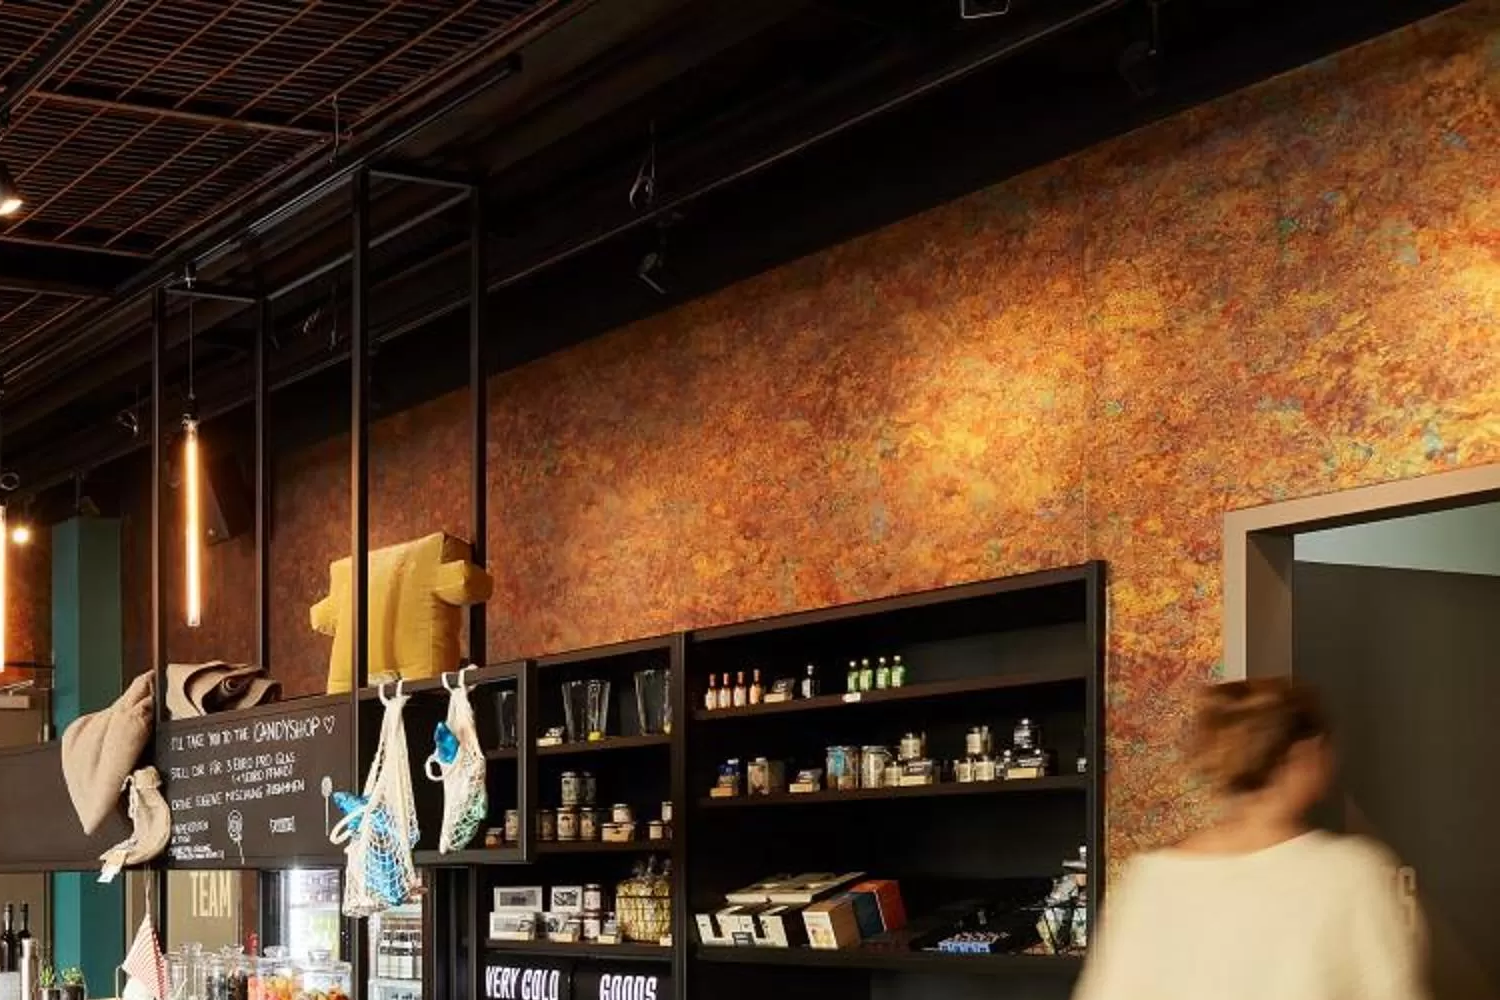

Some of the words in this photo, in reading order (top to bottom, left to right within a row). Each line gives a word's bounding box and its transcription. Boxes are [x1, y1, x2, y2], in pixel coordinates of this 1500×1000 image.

[233, 727, 250, 741] THE
[254, 716, 320, 742] CANDYSHOP
[189, 870, 232, 918] TEAM
[485, 965, 520, 999] VERY
